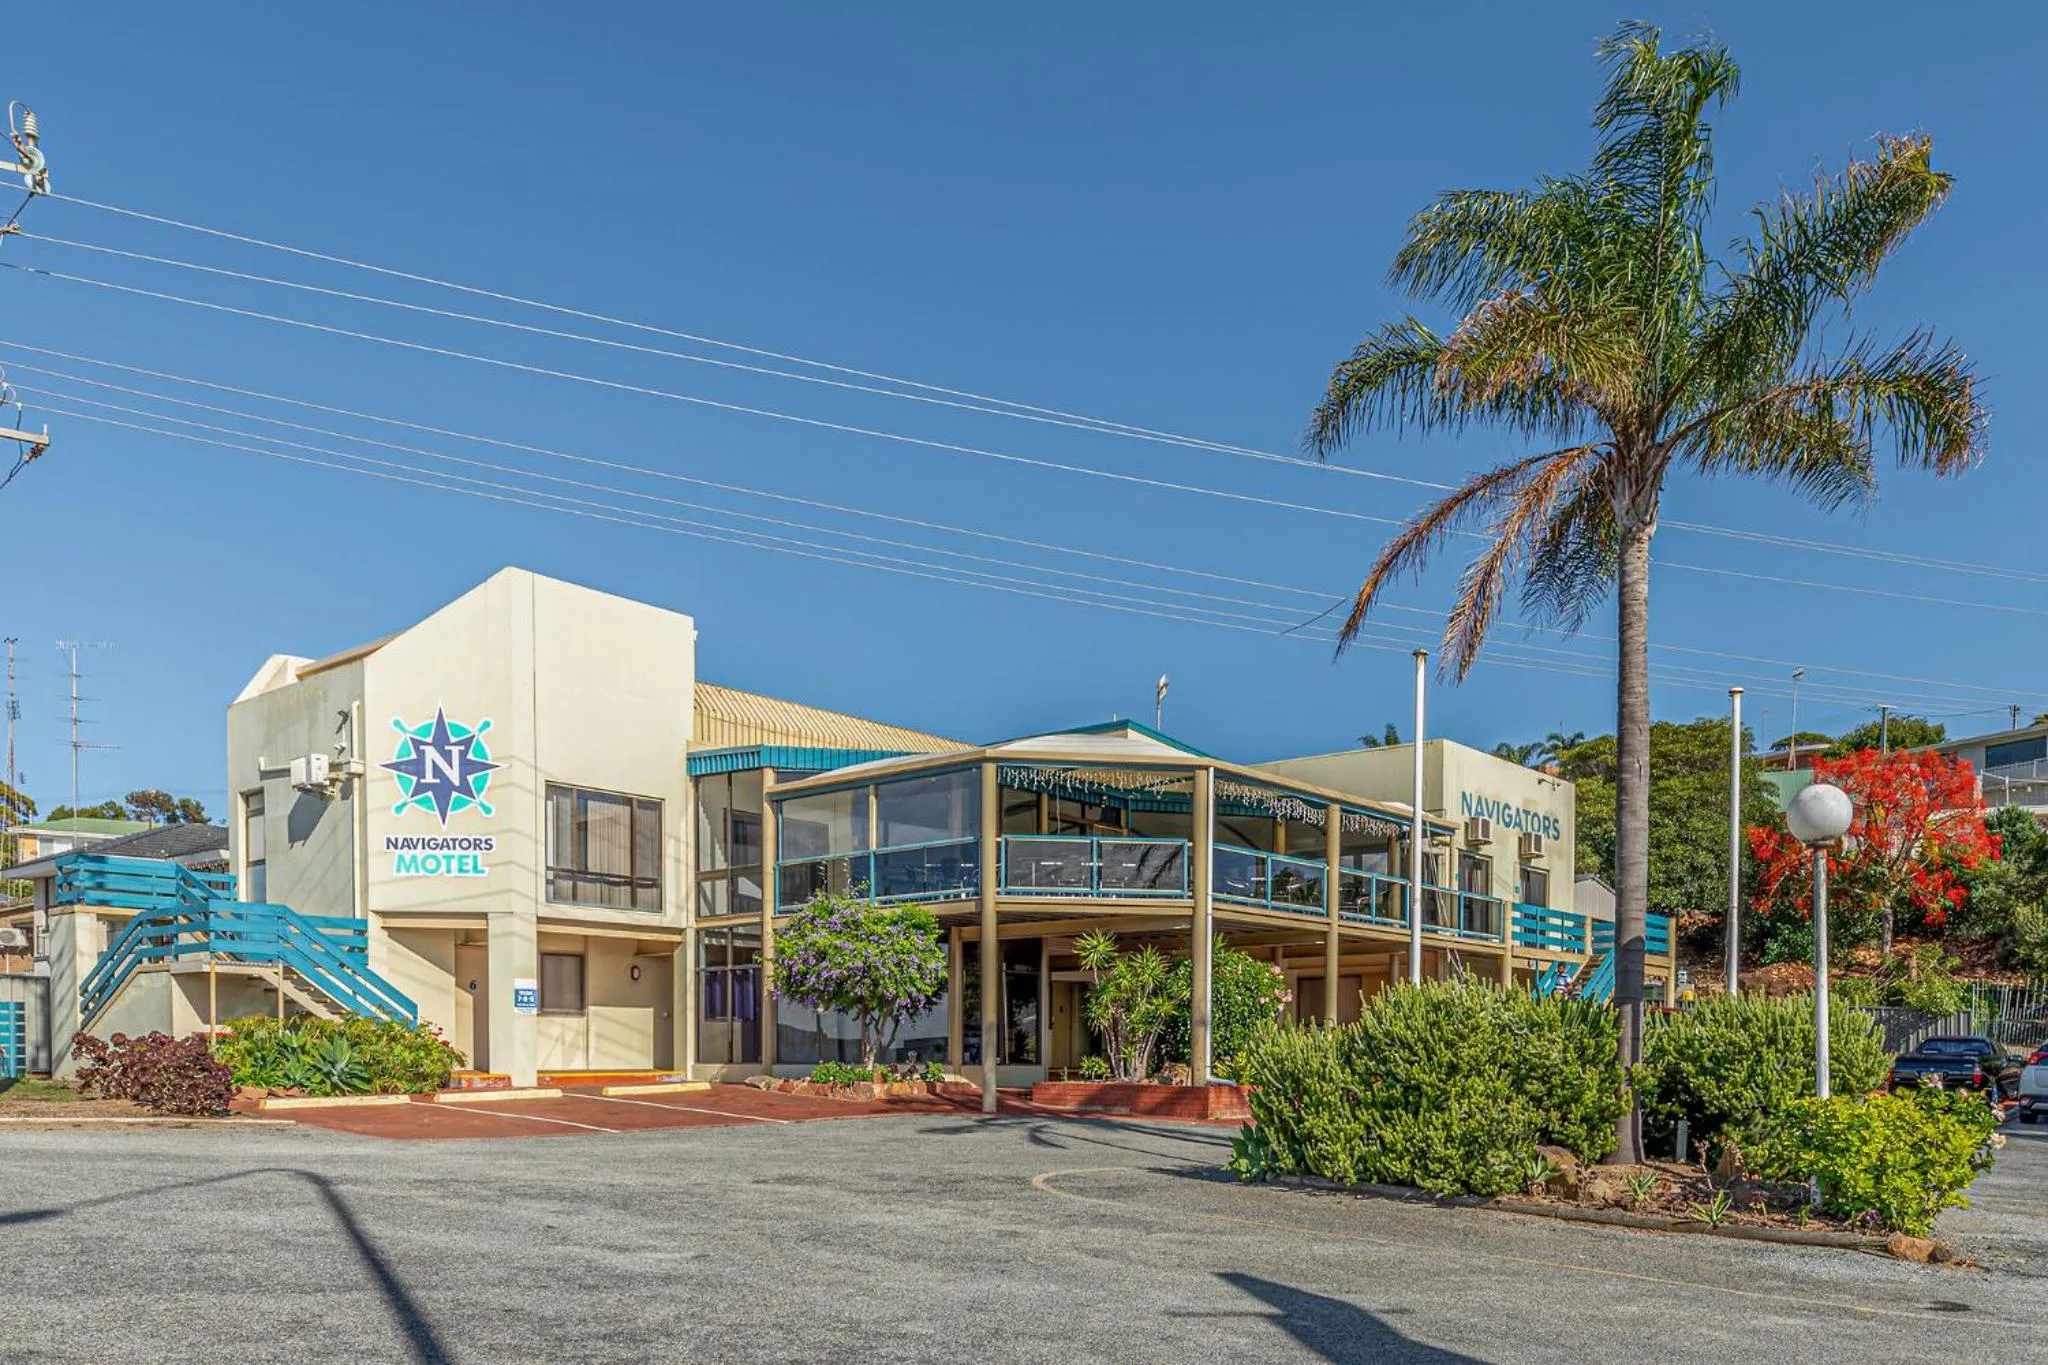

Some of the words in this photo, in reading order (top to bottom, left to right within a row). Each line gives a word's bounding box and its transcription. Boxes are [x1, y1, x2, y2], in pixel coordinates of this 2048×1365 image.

[419, 745, 465, 786] N
[1461, 791, 1560, 841] NAVIGATORS
[385, 836, 494, 851] NAVIGATORS
[395, 854, 486, 875] MOTEL
